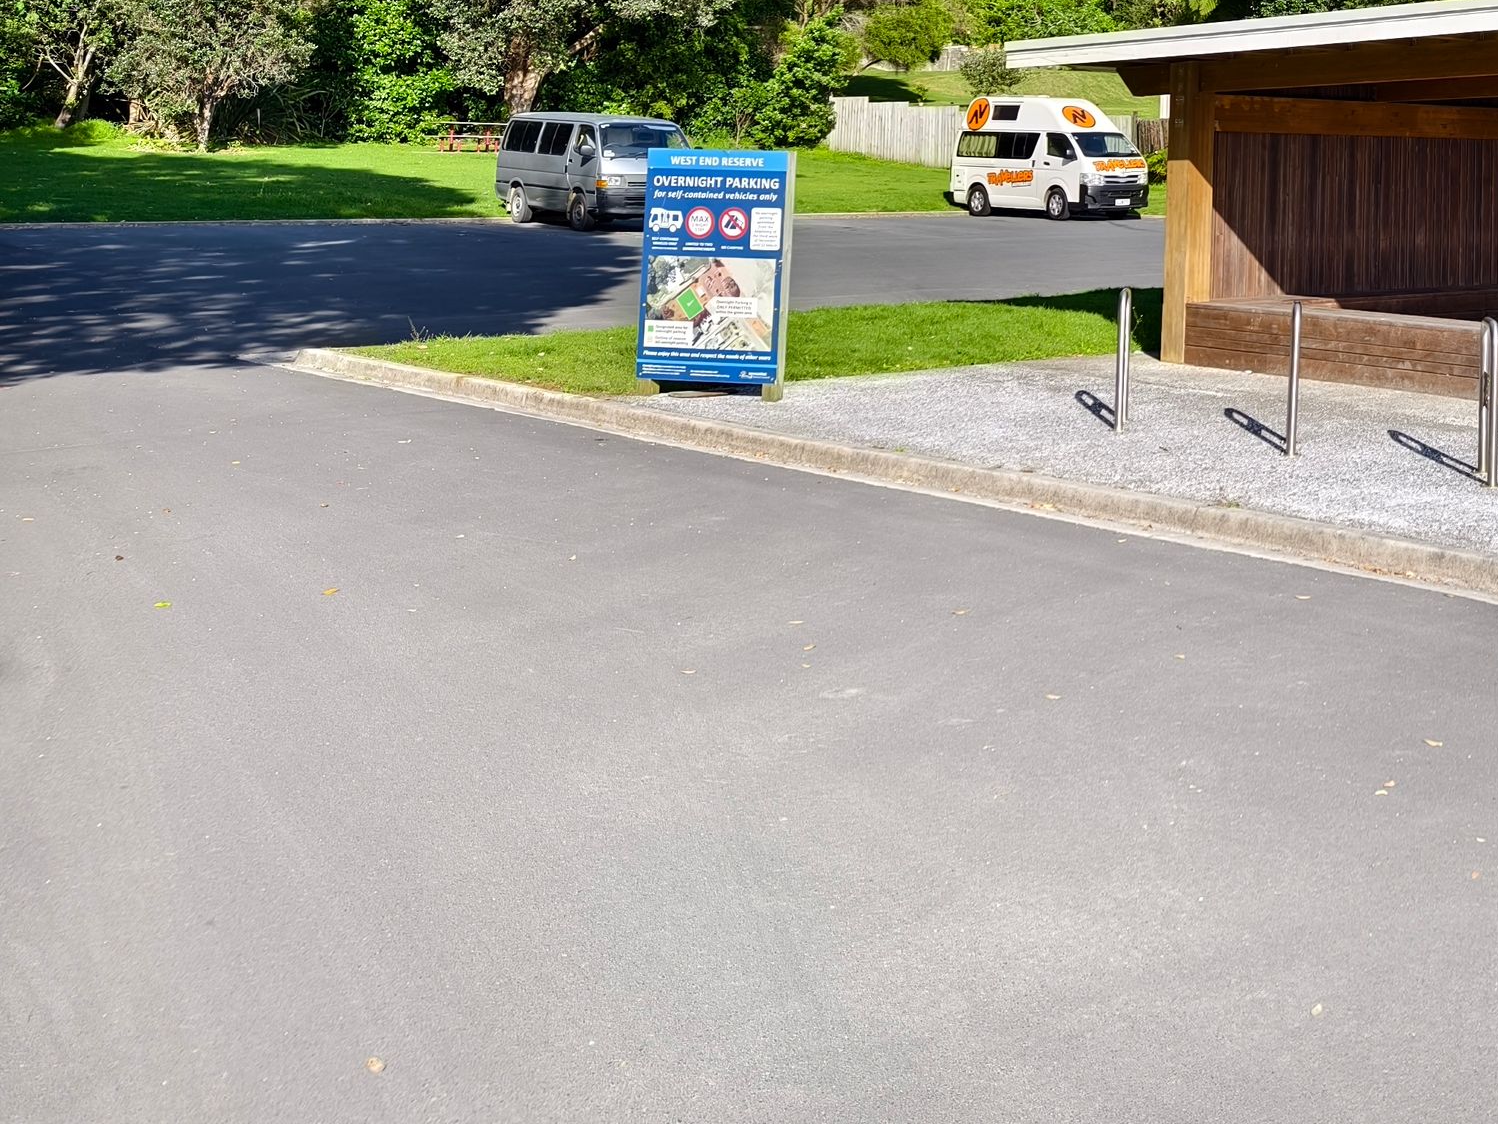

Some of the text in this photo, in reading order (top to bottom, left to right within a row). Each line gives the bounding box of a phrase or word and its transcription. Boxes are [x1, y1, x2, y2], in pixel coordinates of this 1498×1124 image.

[671, 156, 765, 168] WEST END RESERVE
[653, 175, 780, 189] OVERNIGHT PARKING
[653, 189, 778, 203] for self-contained vehicles only
[691, 215, 709, 223] MAX
